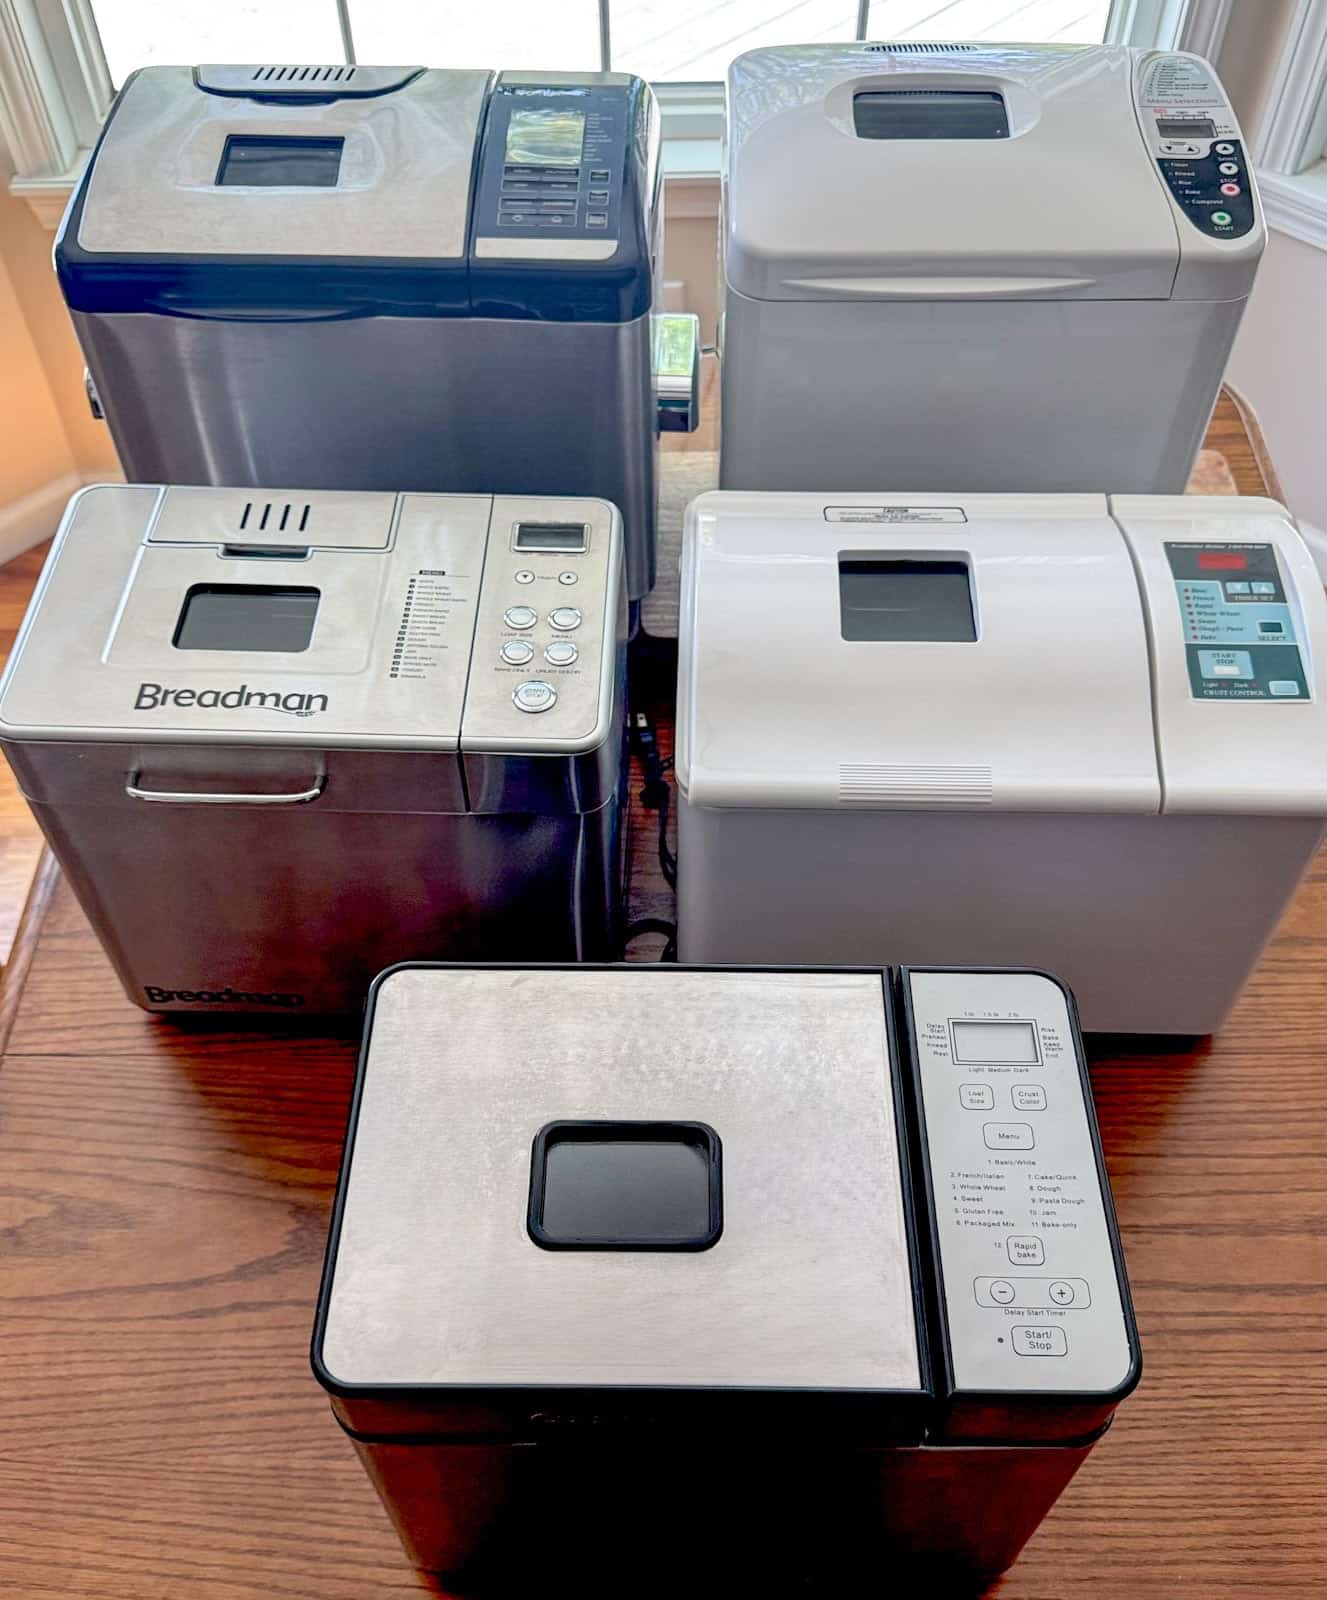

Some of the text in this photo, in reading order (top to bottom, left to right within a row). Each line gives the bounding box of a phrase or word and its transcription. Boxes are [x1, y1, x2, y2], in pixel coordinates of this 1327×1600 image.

[134, 683, 329, 711] Breadman
[144, 985, 304, 1008] Breadman
[1025, 1330, 1052, 1339] Start/
[1029, 1341, 1052, 1350] Stop
